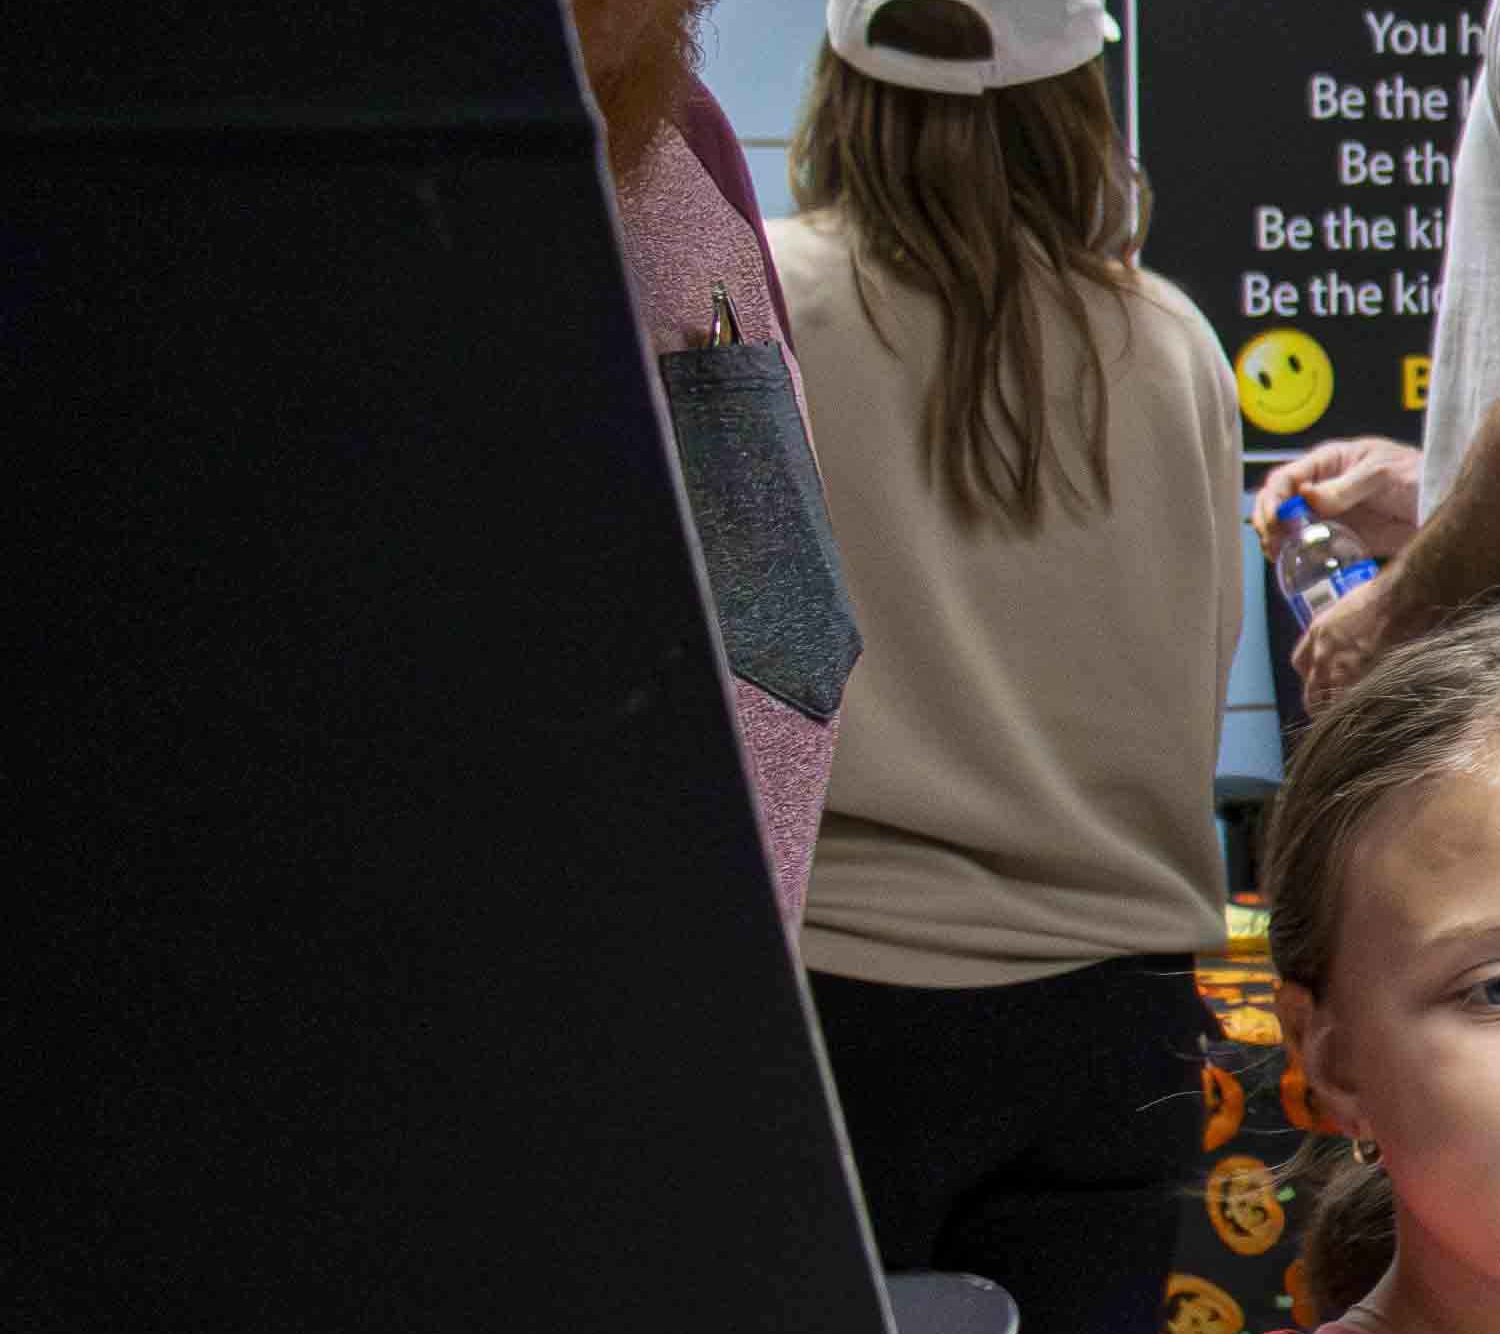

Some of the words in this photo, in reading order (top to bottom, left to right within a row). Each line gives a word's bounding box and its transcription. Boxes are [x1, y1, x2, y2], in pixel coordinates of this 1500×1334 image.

[1364, 11, 1447, 55] You
[1309, 74, 1367, 121] Be
[1375, 76, 1448, 121] the
[1339, 141, 1394, 186] Be
[1405, 142, 1452, 186] th
[1255, 205, 1313, 251] Be
[1322, 206, 1396, 251] the
[1407, 207, 1445, 251] ki
[1241, 271, 1300, 318] Be
[1309, 271, 1382, 317] the
